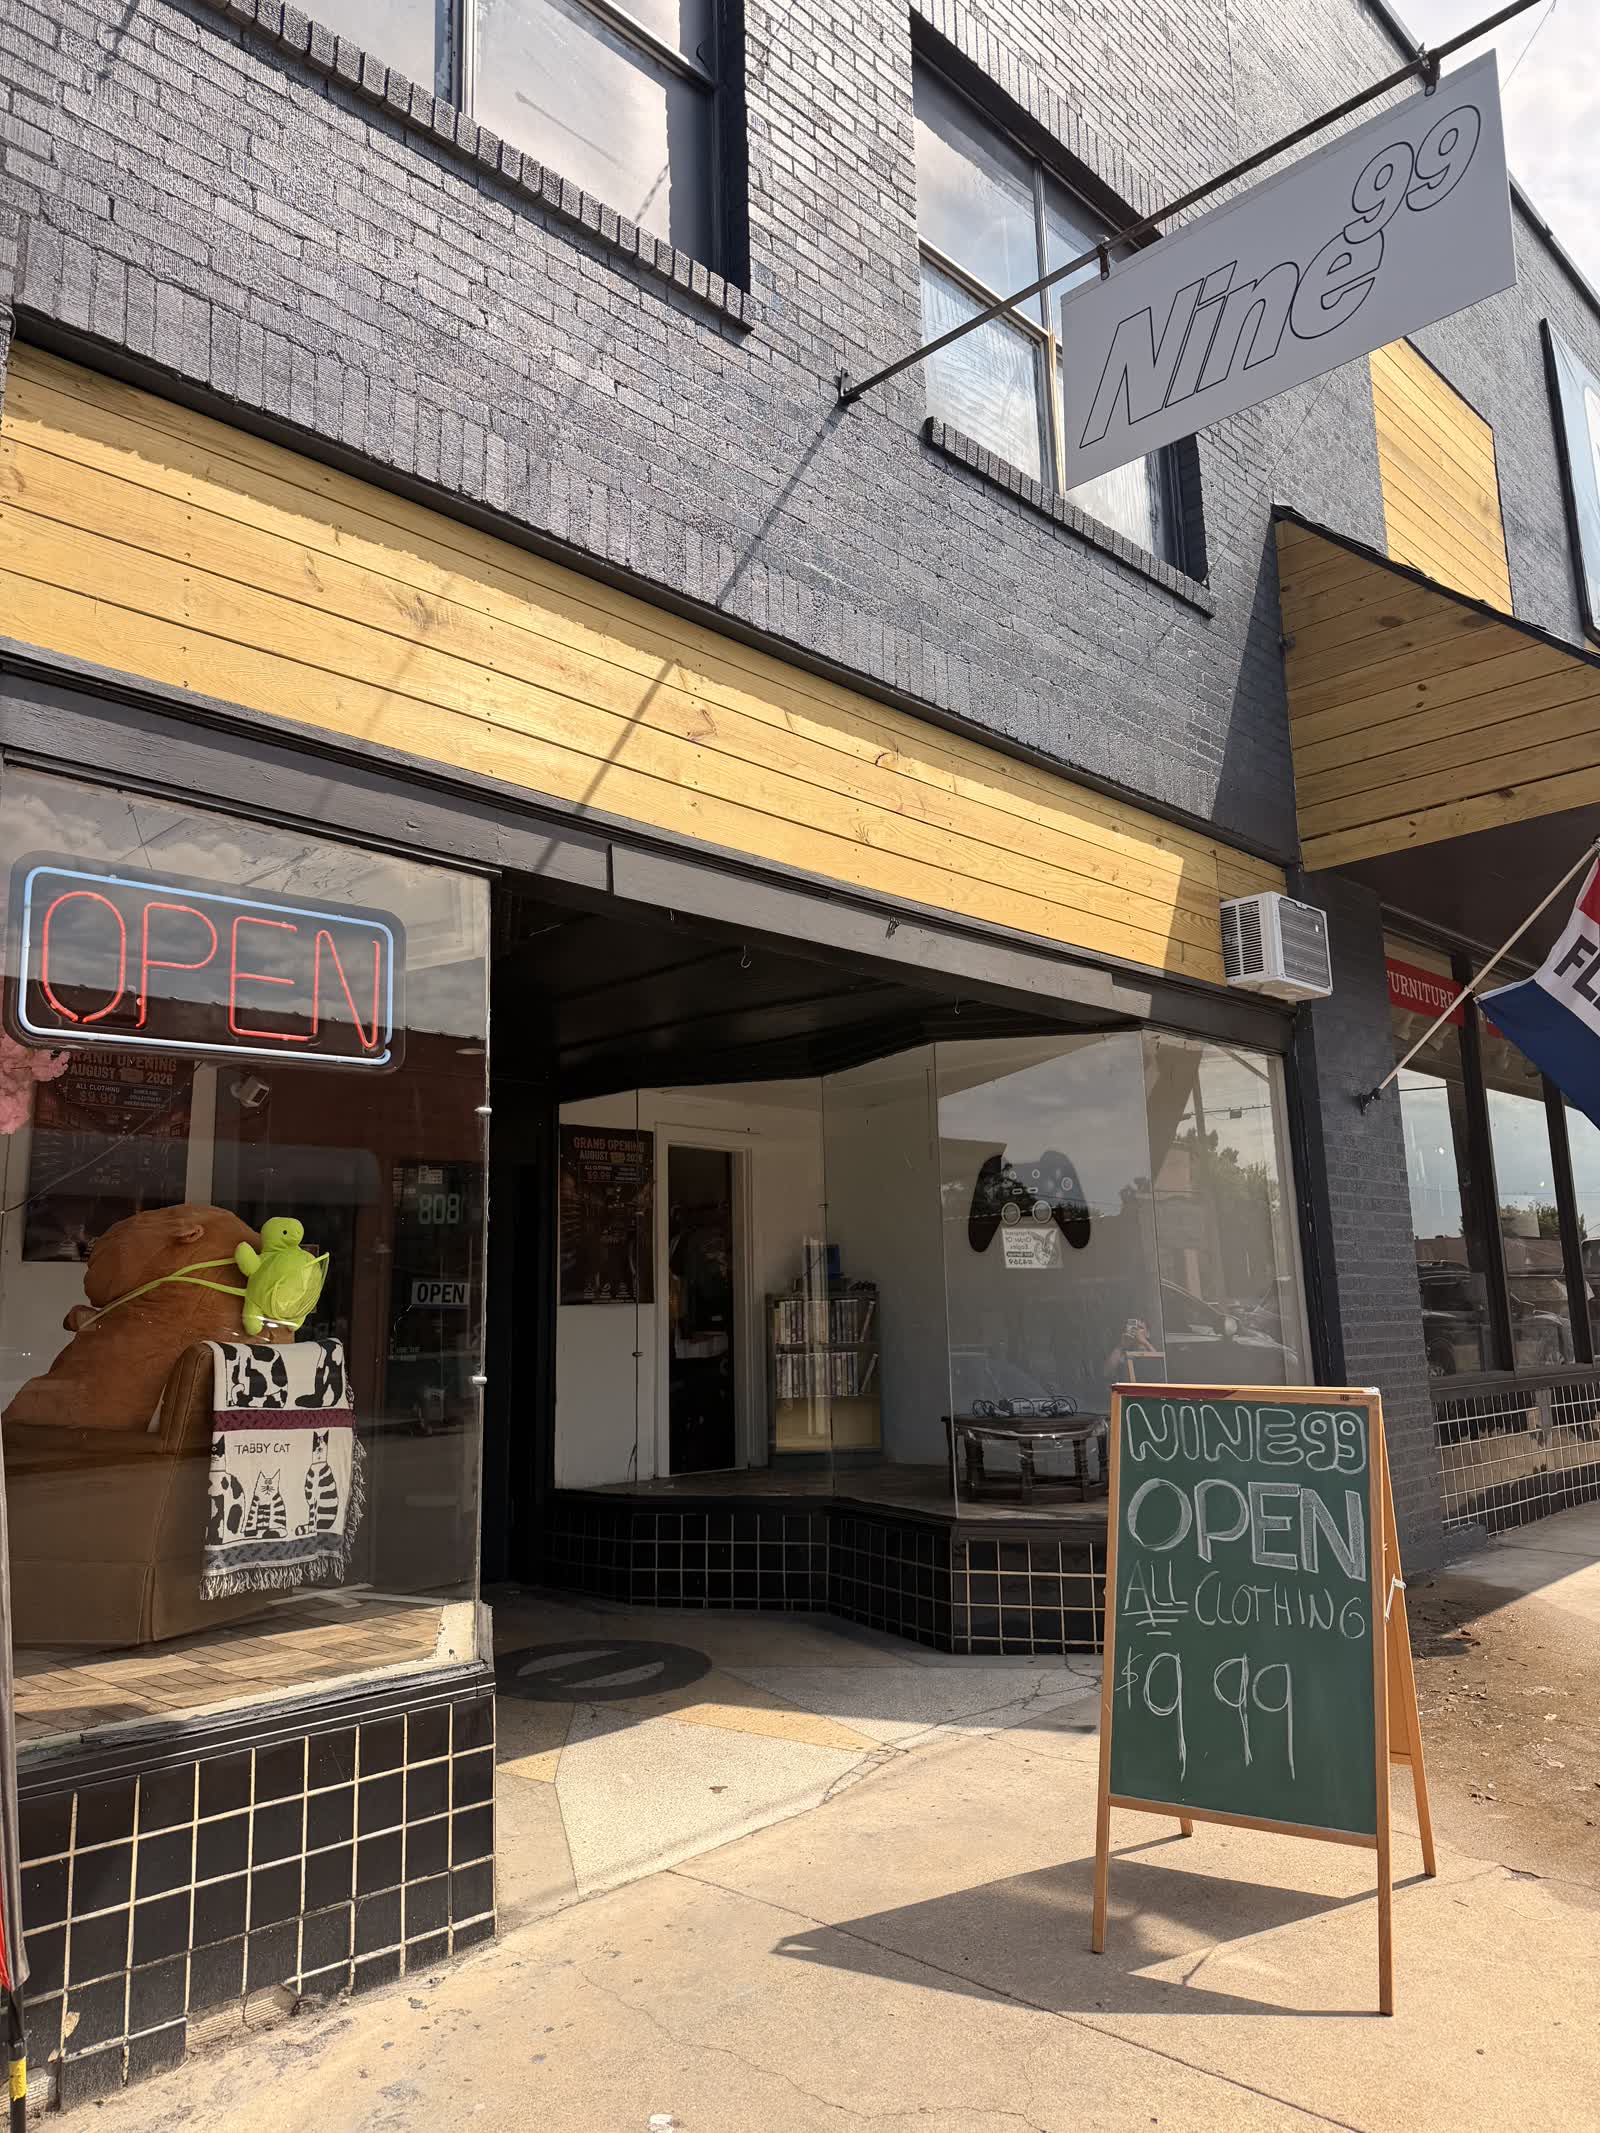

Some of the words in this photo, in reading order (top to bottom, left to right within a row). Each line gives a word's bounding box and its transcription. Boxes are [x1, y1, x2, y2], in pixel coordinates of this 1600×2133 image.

[41, 891, 381, 1049] OPEN
[1553, 934, 1600, 1011] FL
[1386, 970, 1455, 1009] URNITURE
[70, 1063, 117, 1080] AUGUST
[76, 1082, 87, 1090] ALL
[89, 1083, 120, 1094] CLOTHING
[574, 1136, 606, 1150] GRAND
[580, 1149, 608, 1161] AUGUST
[418, 1193, 461, 1225] 808
[417, 1282, 465, 1304] OPEN
[234, 1442, 271, 1454] TABBY
[273, 1442, 291, 1453] CAT
[1127, 1478, 1367, 1581] OPEN
[1122, 1560, 1189, 1628] ALL
[1195, 1570, 1366, 1639] CLOTHING
